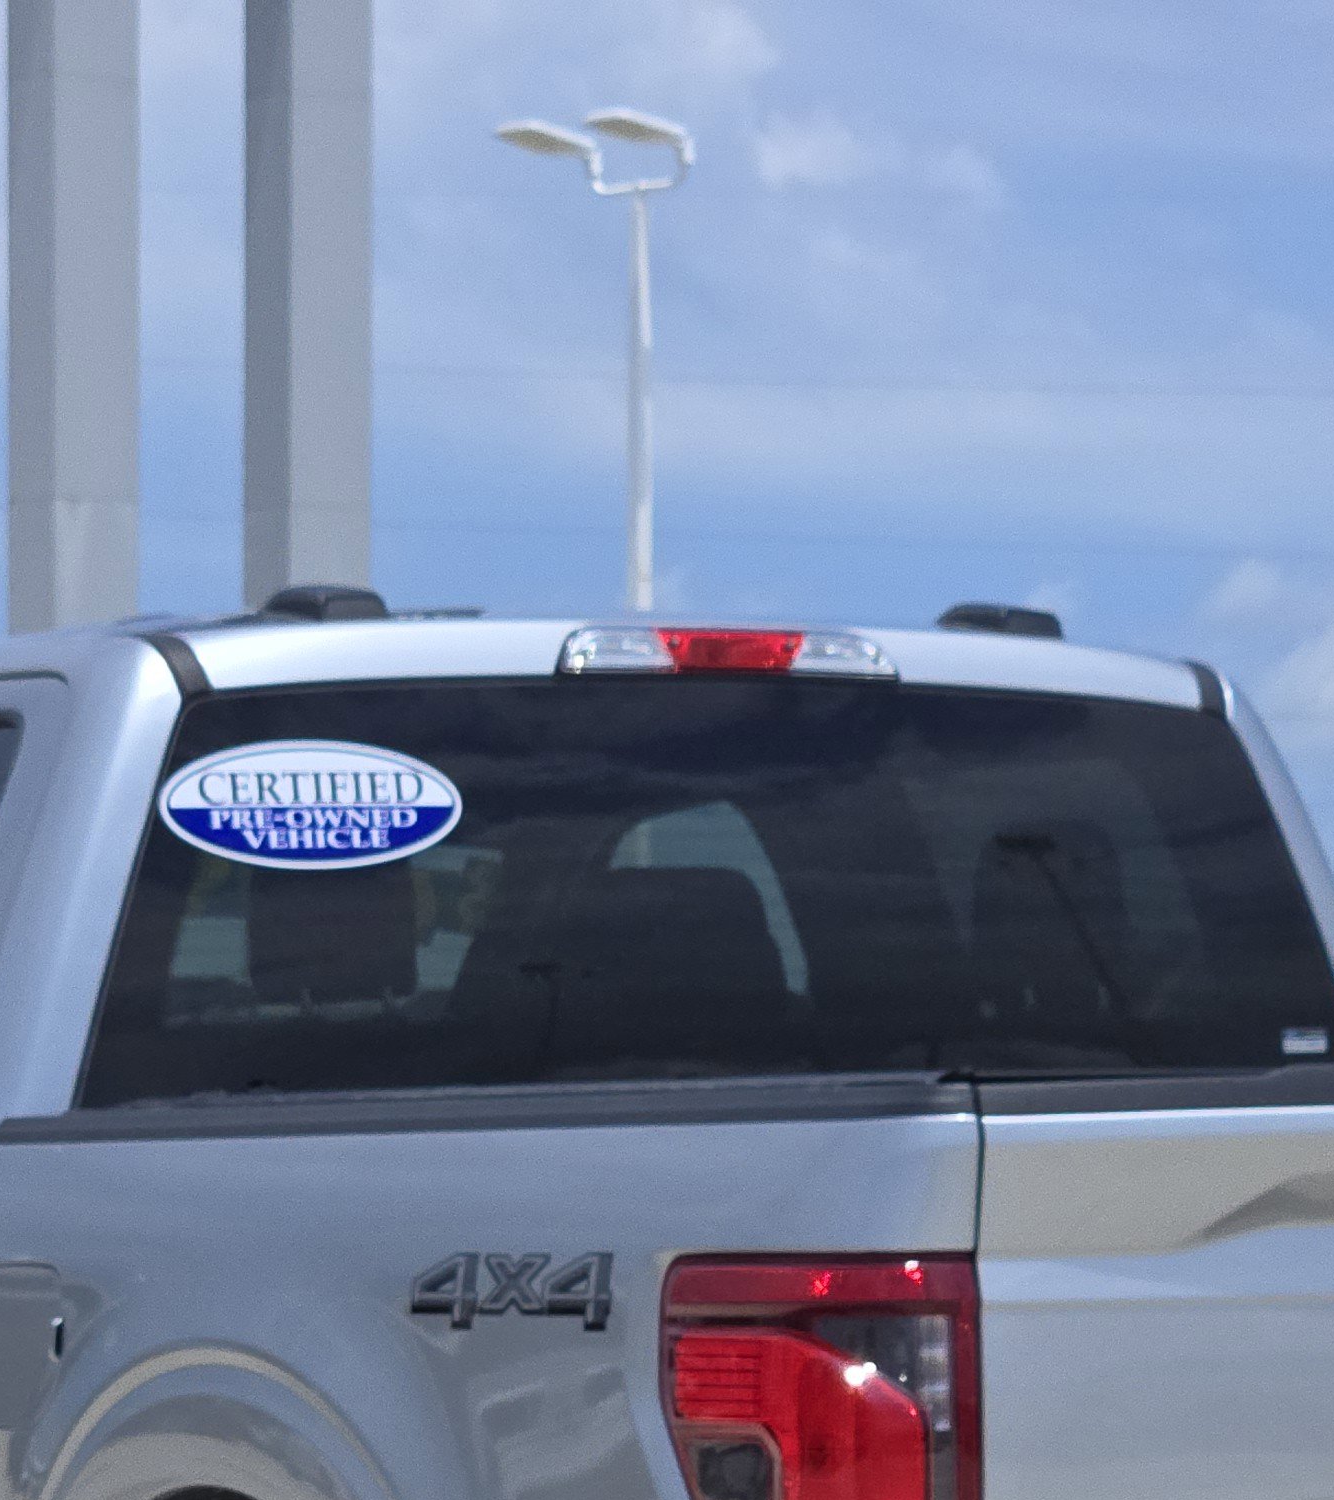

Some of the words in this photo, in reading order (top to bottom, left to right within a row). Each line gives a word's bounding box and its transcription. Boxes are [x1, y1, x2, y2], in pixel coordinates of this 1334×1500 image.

[198, 770, 424, 806] CERTIFIED
[208, 808, 418, 830] PRE-OWNED
[242, 829, 391, 850] VEHICLE
